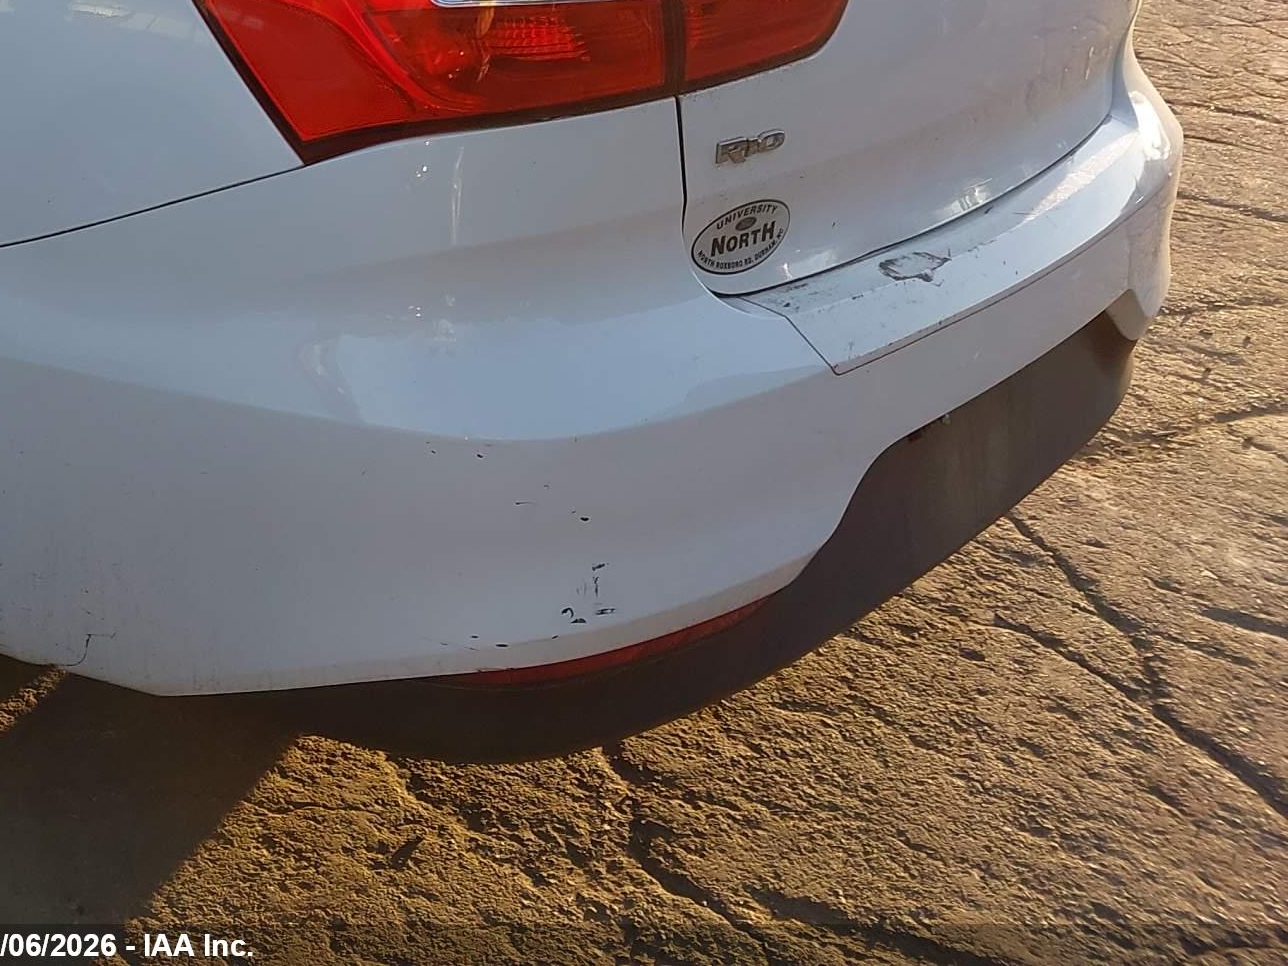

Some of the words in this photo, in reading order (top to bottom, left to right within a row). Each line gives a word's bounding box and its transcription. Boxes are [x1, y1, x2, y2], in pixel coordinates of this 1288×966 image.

[716, 204, 778, 230] UNIVERSITY
[711, 220, 776, 257] NORTH
[698, 250, 714, 267] NORTH
